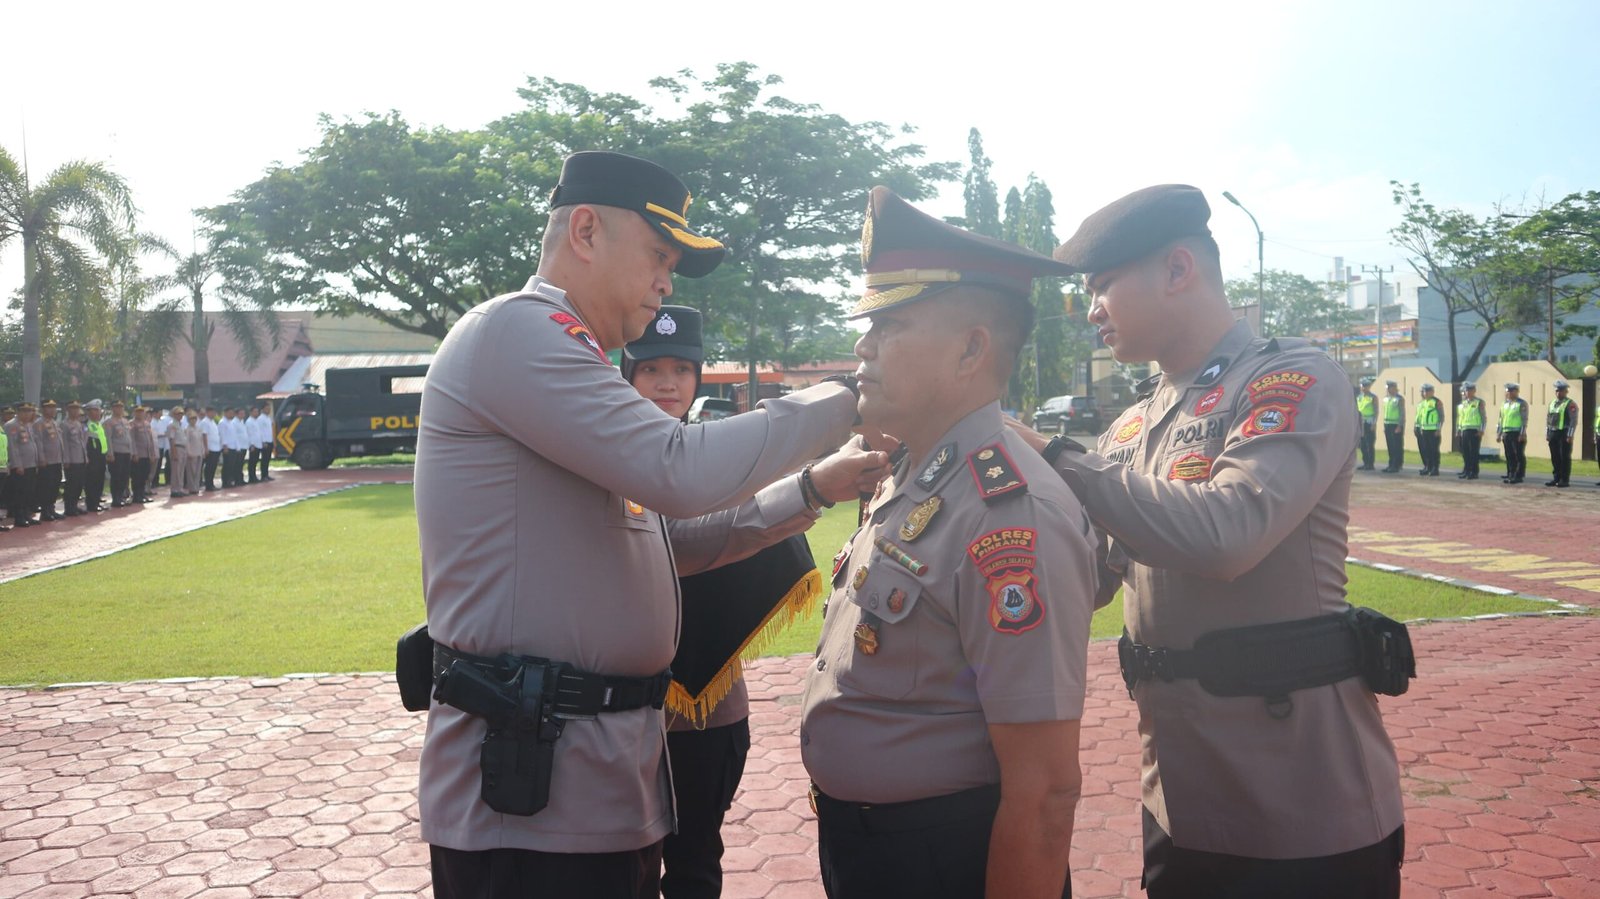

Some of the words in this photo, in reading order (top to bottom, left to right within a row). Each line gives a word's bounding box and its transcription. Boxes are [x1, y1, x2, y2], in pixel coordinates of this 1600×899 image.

[1173, 417, 1224, 447] POLRI
[971, 530, 1033, 554] POLRES
[978, 539, 1028, 557] PINRANG
